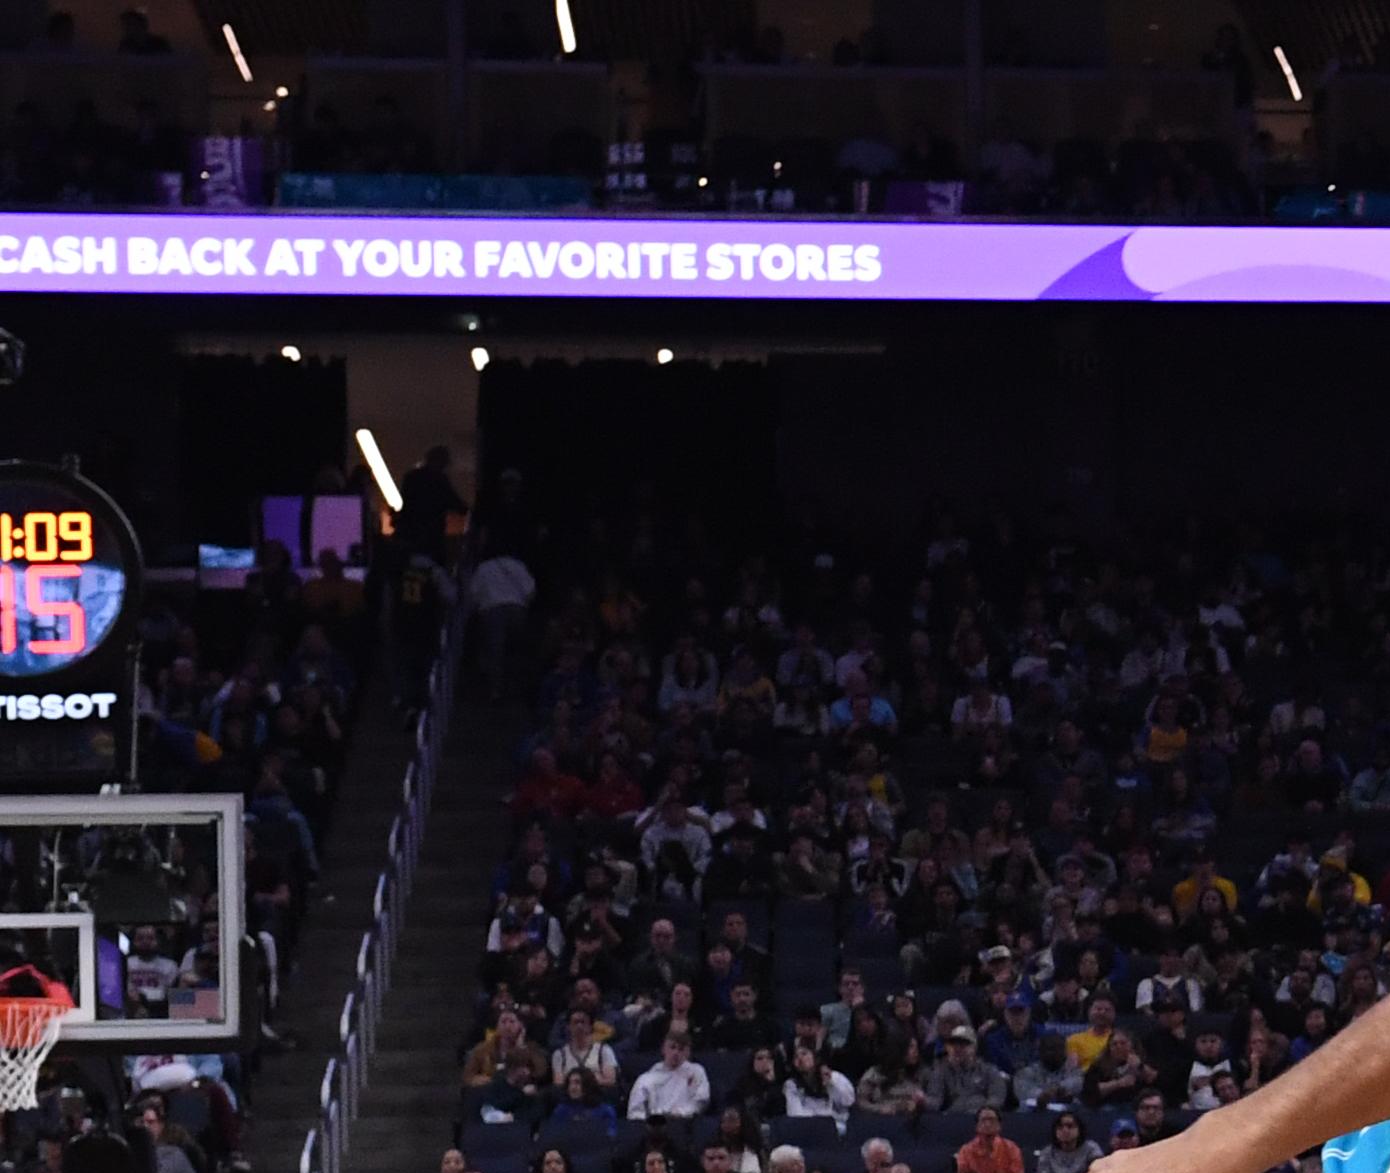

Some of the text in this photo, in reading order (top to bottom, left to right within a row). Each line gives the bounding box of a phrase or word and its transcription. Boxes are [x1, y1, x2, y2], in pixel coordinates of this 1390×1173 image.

[0, 235, 882, 281] CASH BACK AT YOUR FAVORITE STORES
[0, 692, 116, 721] ISSOT
